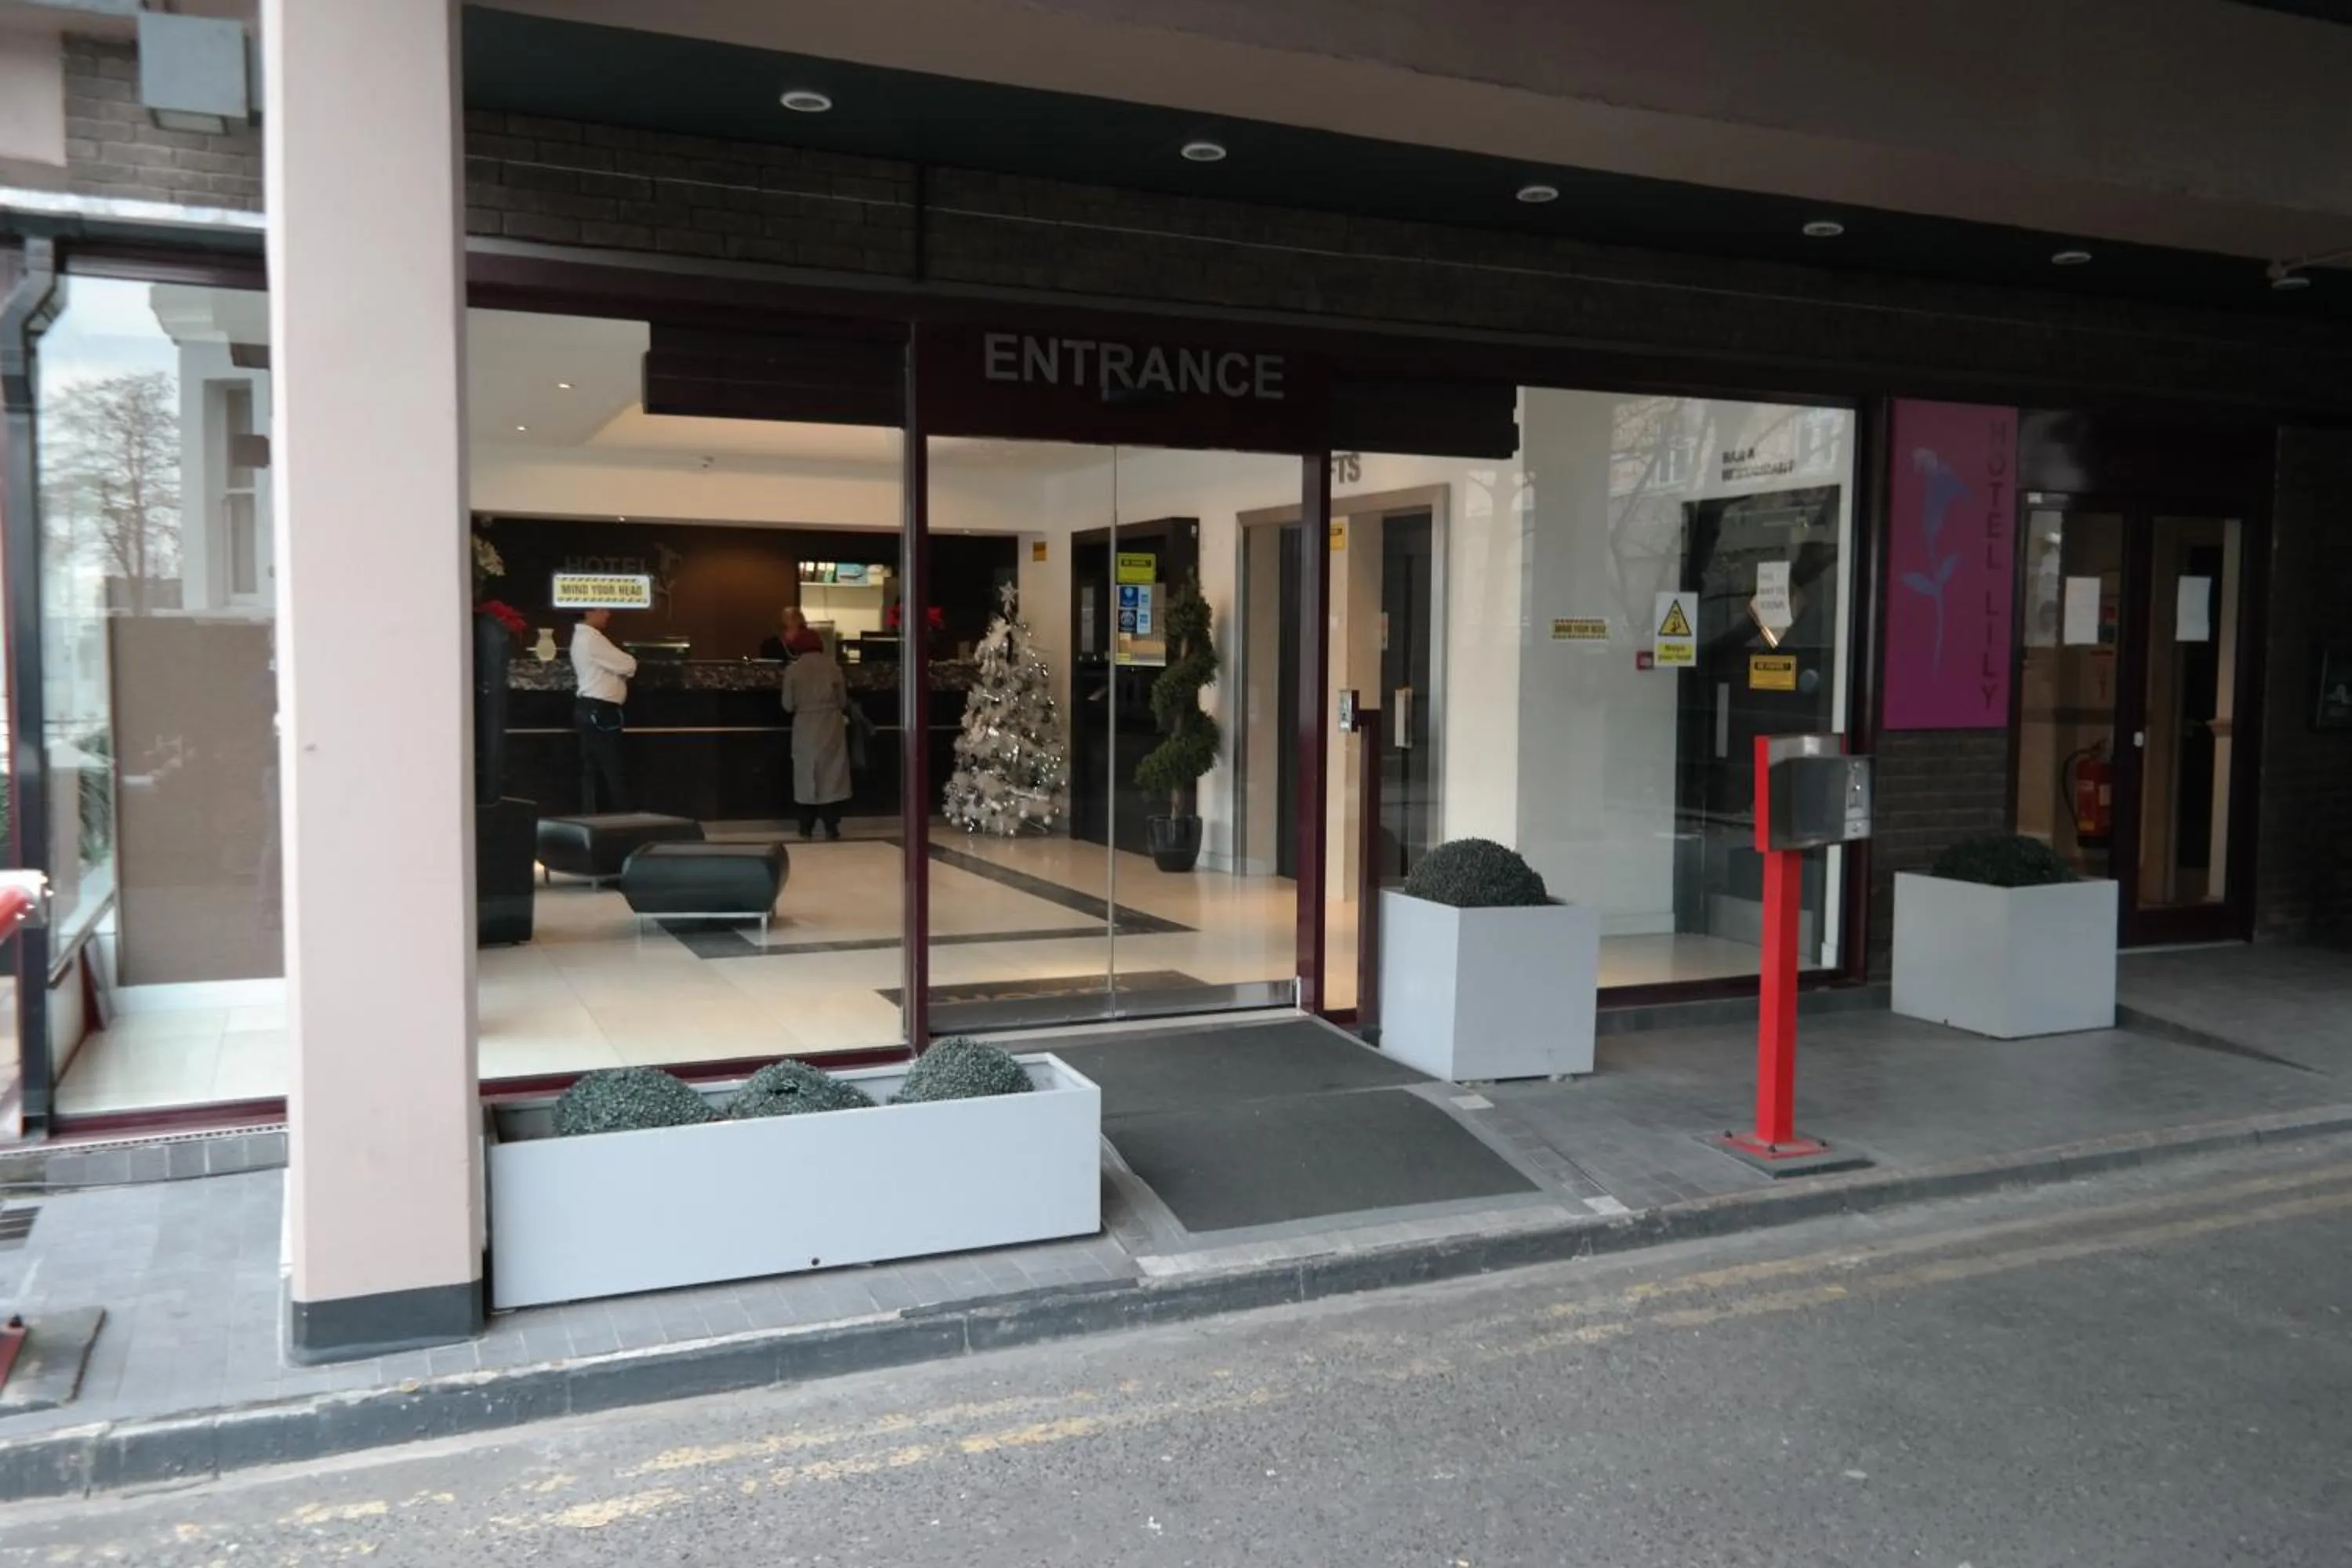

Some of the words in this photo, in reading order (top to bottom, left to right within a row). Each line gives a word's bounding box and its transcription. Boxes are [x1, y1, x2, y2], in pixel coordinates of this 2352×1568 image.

[985, 332, 1285, 401] ENTRANCE
[1986, 419, 2008, 571] HOTEL
[1980, 590, 1999, 710] LILY
